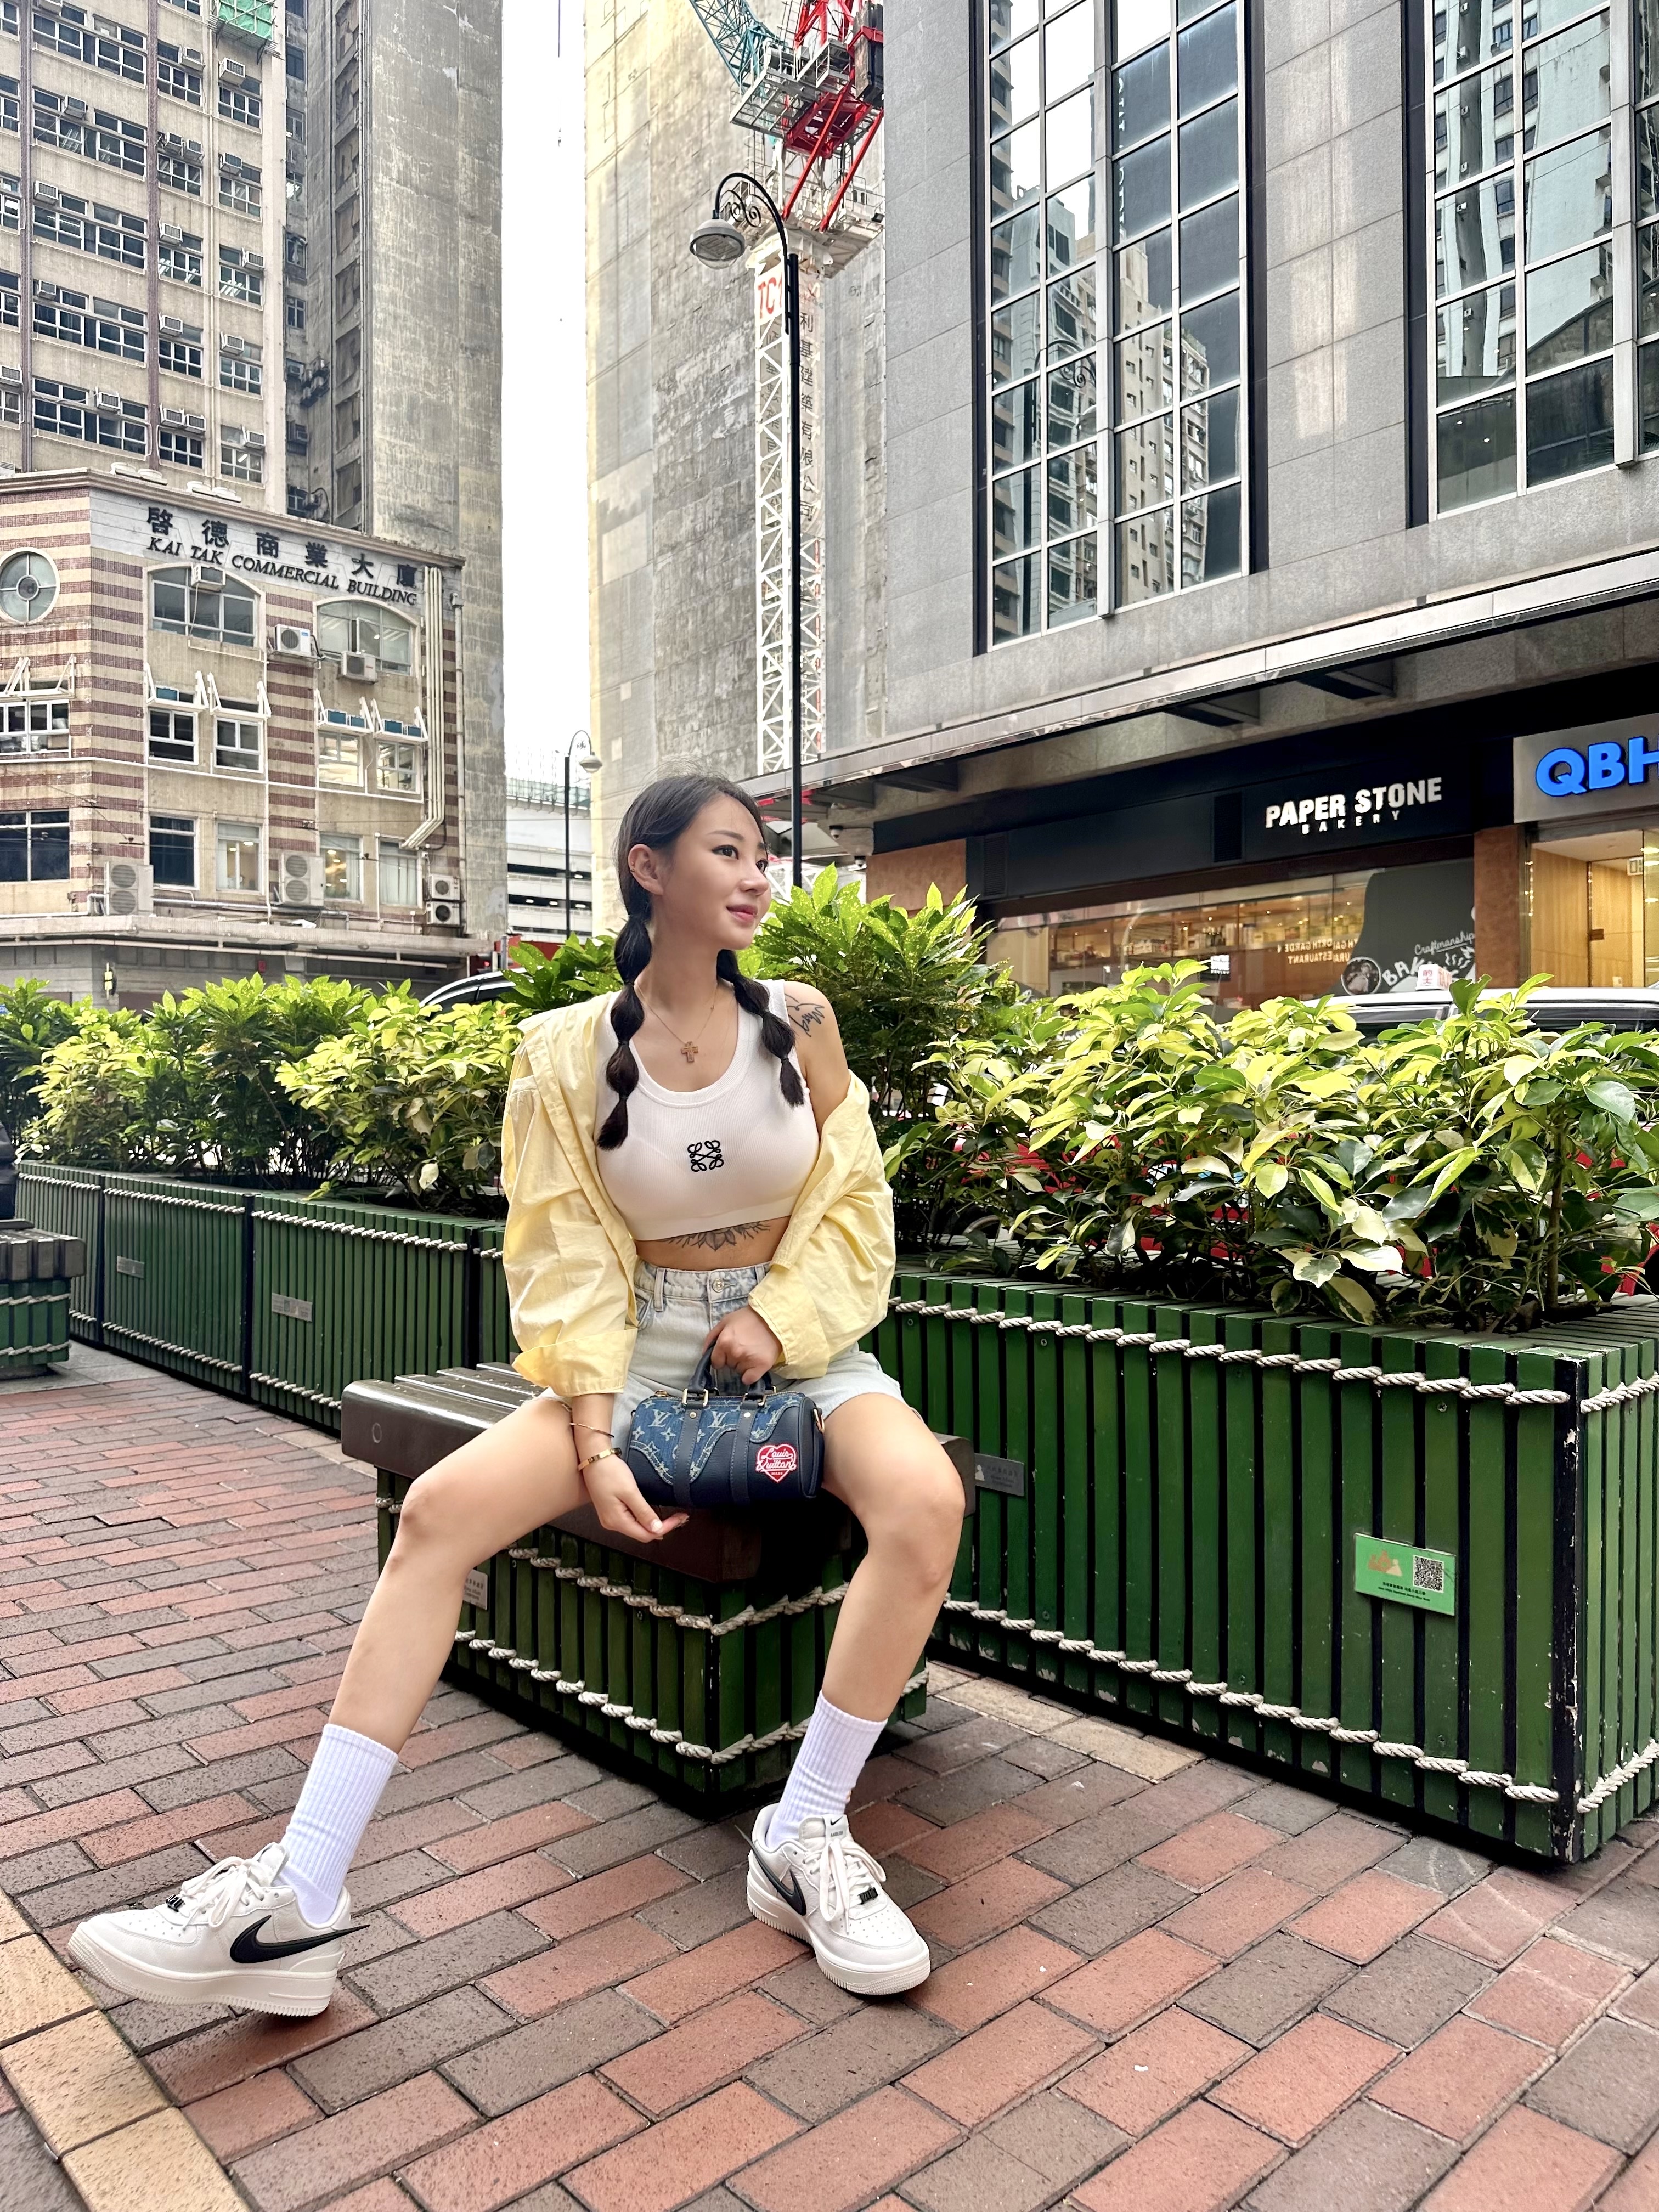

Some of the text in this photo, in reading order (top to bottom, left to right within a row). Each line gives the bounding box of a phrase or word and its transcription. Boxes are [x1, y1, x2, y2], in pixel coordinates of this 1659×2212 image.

[146, 537, 417, 606] KAI TAK COMMERCIAL BUILDING
[1265, 777, 1442, 828] PAPER STONE
[1301, 810, 1400, 834] BAKERY
[761, 1447, 793, 1460] Louis
